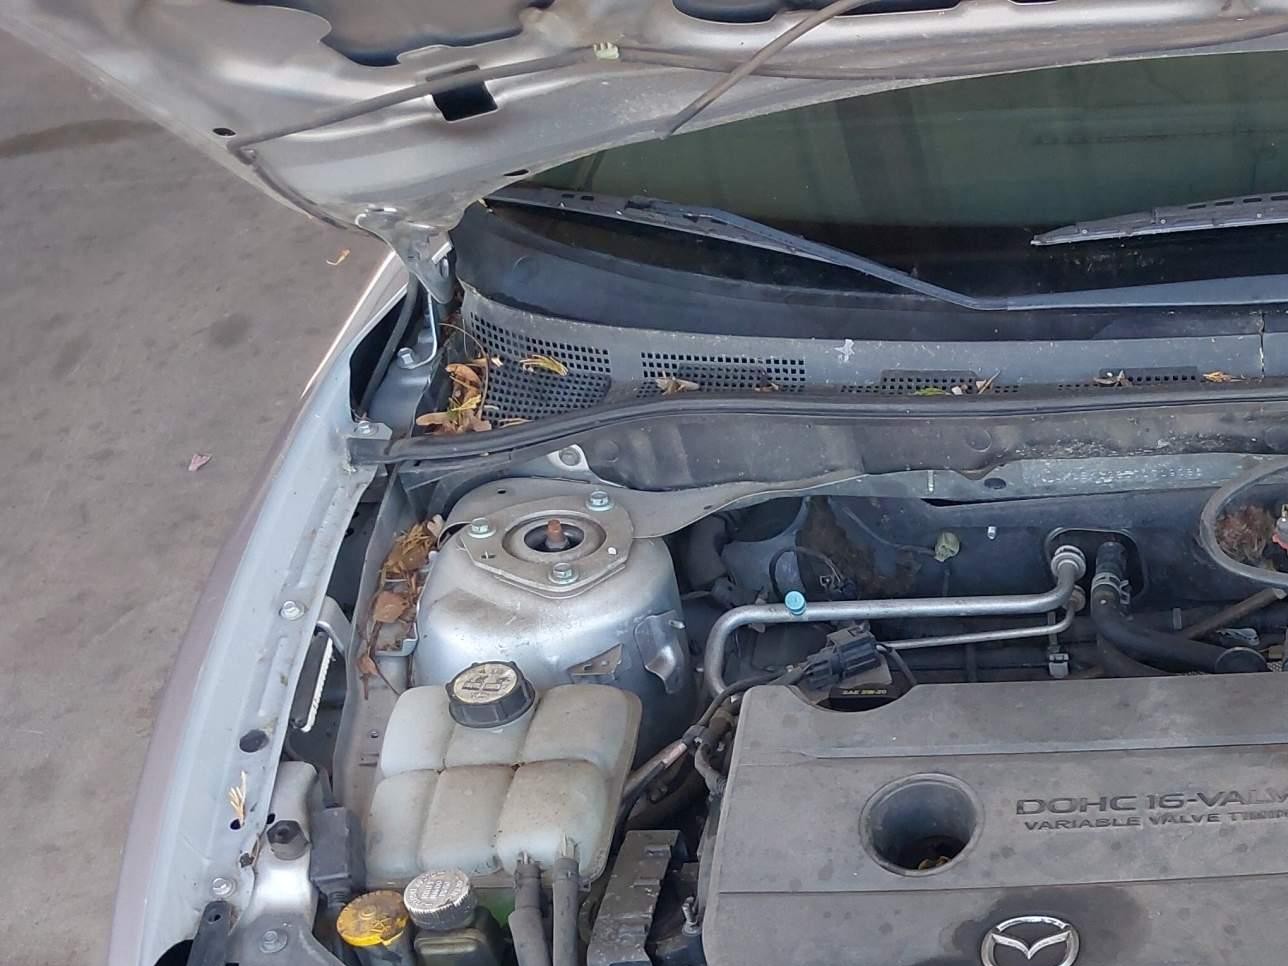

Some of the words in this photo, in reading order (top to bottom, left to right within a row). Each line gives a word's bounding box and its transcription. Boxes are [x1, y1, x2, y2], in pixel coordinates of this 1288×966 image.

[1016, 795, 1137, 816] DOHC
[1024, 816, 1142, 831] VARIABLE
[1148, 813, 1221, 825] VALVE
